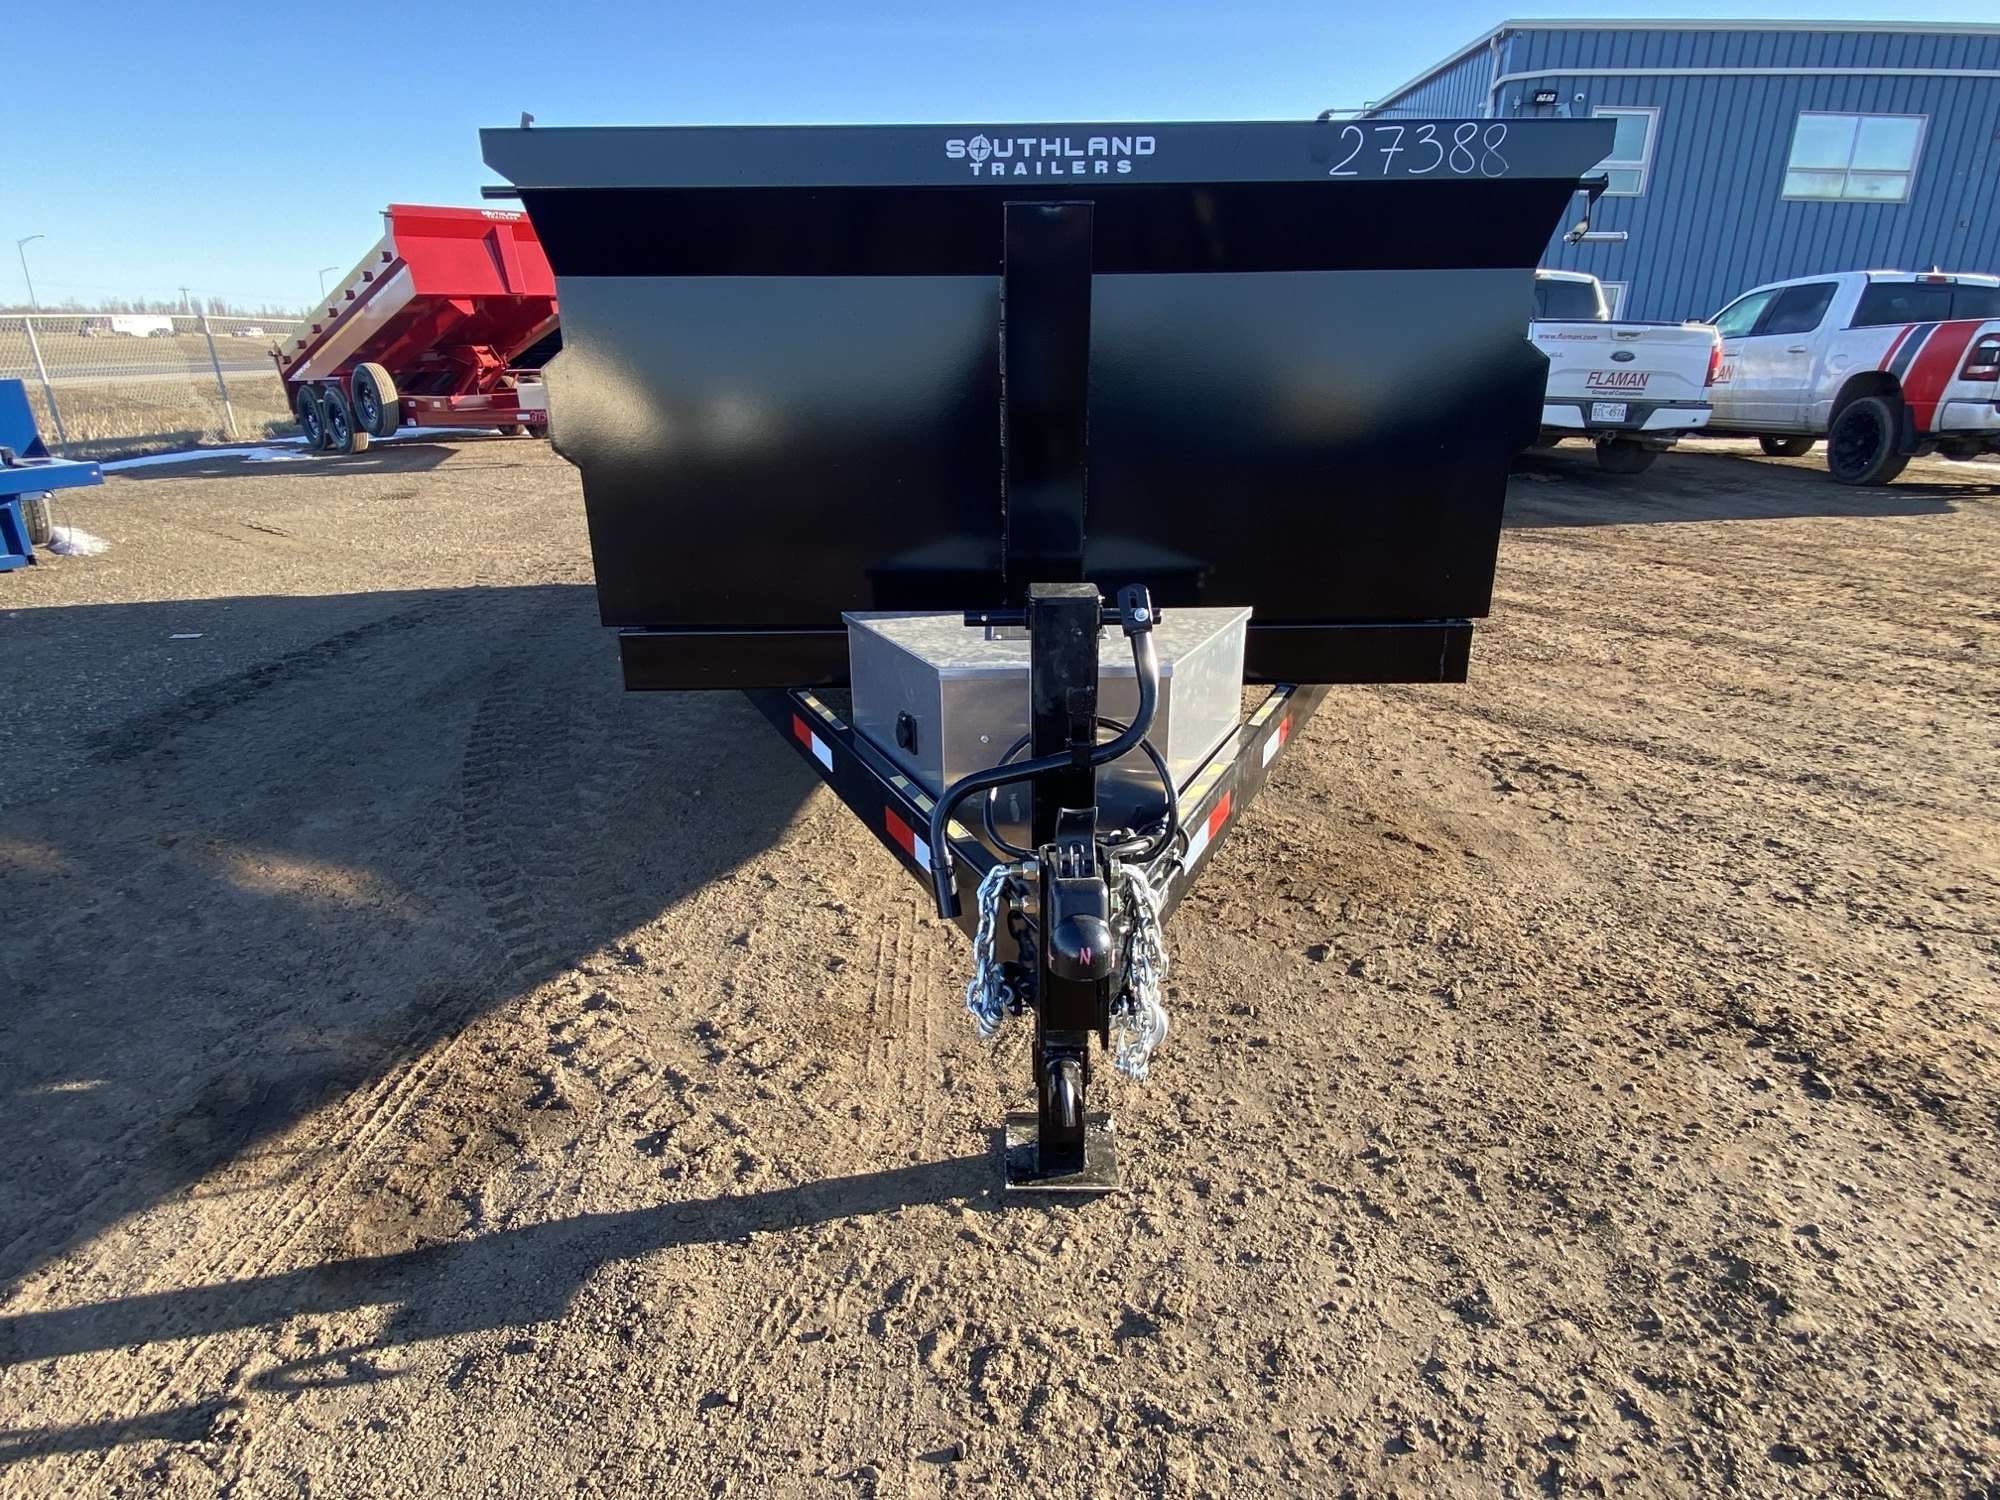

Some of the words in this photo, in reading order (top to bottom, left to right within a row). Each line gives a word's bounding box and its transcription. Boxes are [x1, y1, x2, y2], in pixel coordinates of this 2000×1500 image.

[945, 135, 1156, 161] SOUTHLAND
[1329, 122, 1510, 177] 27388
[969, 160, 1132, 176] TRAILERS
[1587, 371, 1650, 387] FLAMAN
